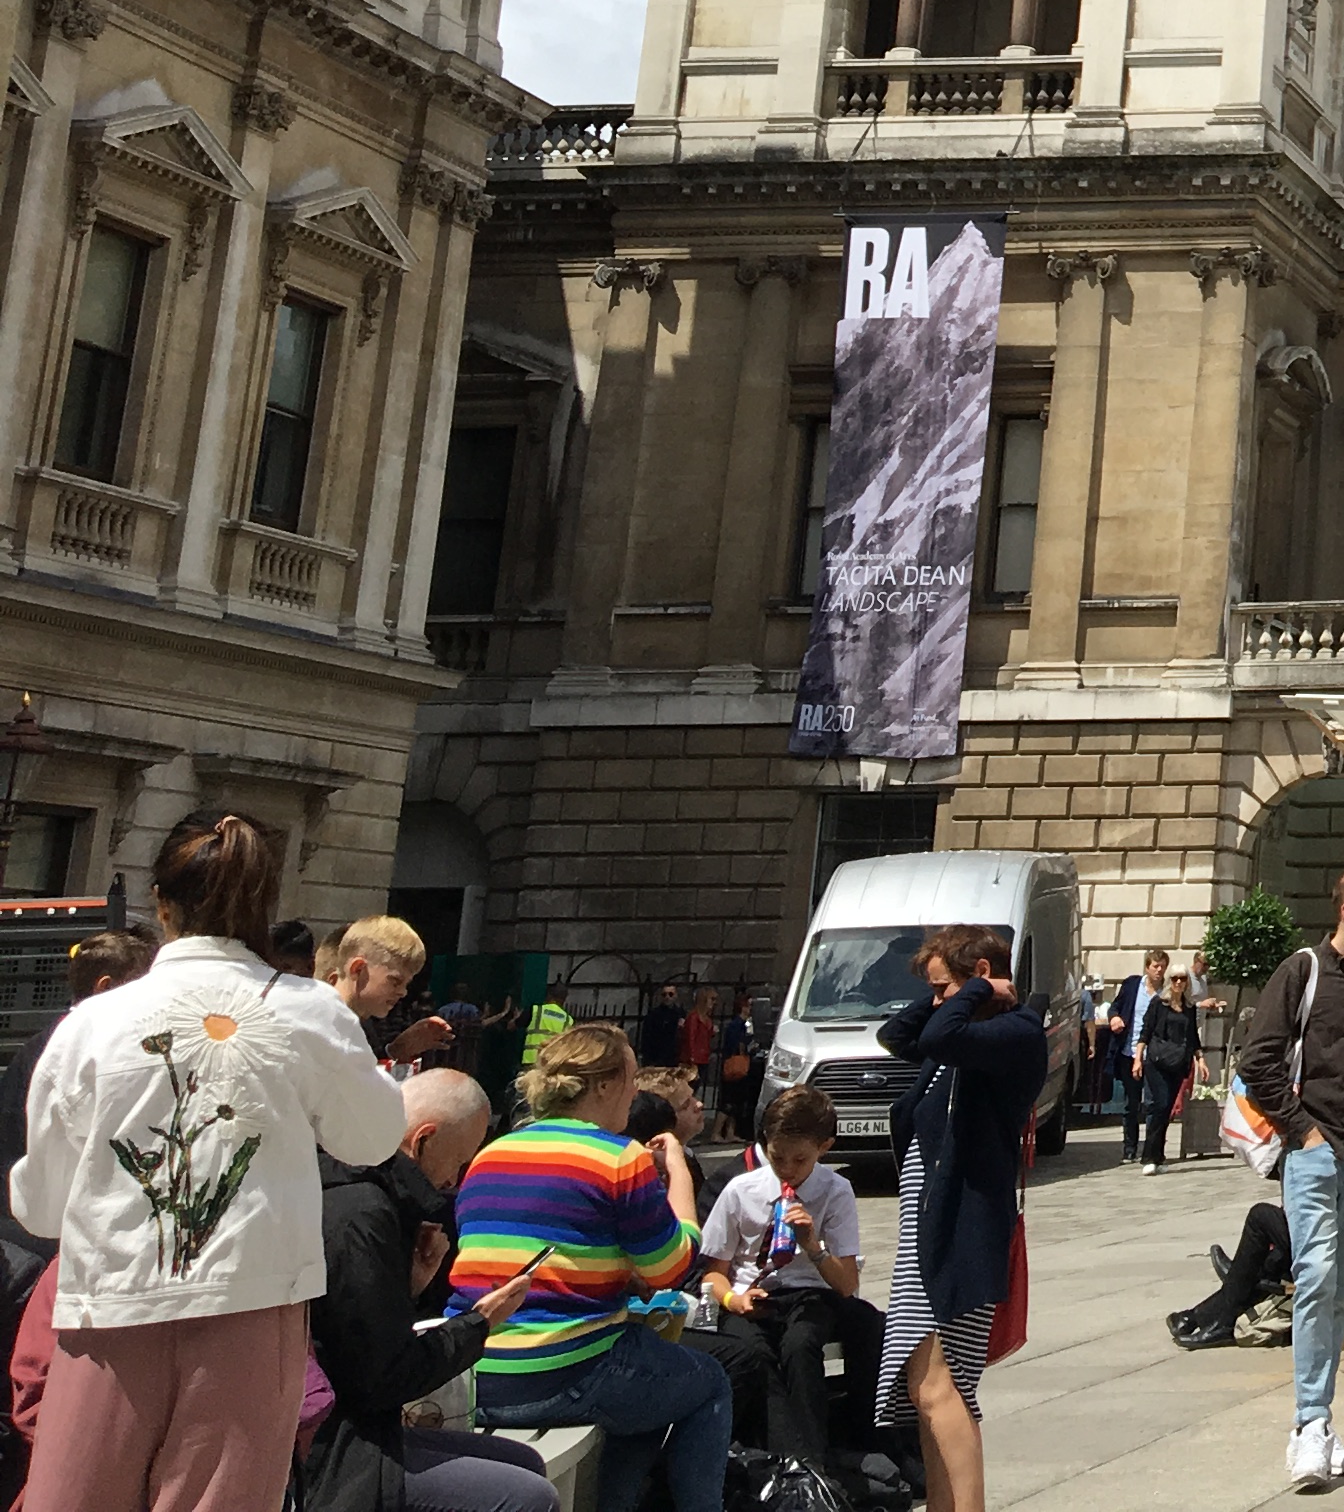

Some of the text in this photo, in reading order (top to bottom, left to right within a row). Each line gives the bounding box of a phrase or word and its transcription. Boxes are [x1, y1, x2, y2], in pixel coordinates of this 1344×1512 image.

[844, 227, 930, 319] RA
[826, 565, 966, 586] TACITA DEAN
[820, 591, 939, 612] LANDSCAPE
[798, 704, 855, 733] RA250
[838, 1121, 889, 1134] LG64 NL
